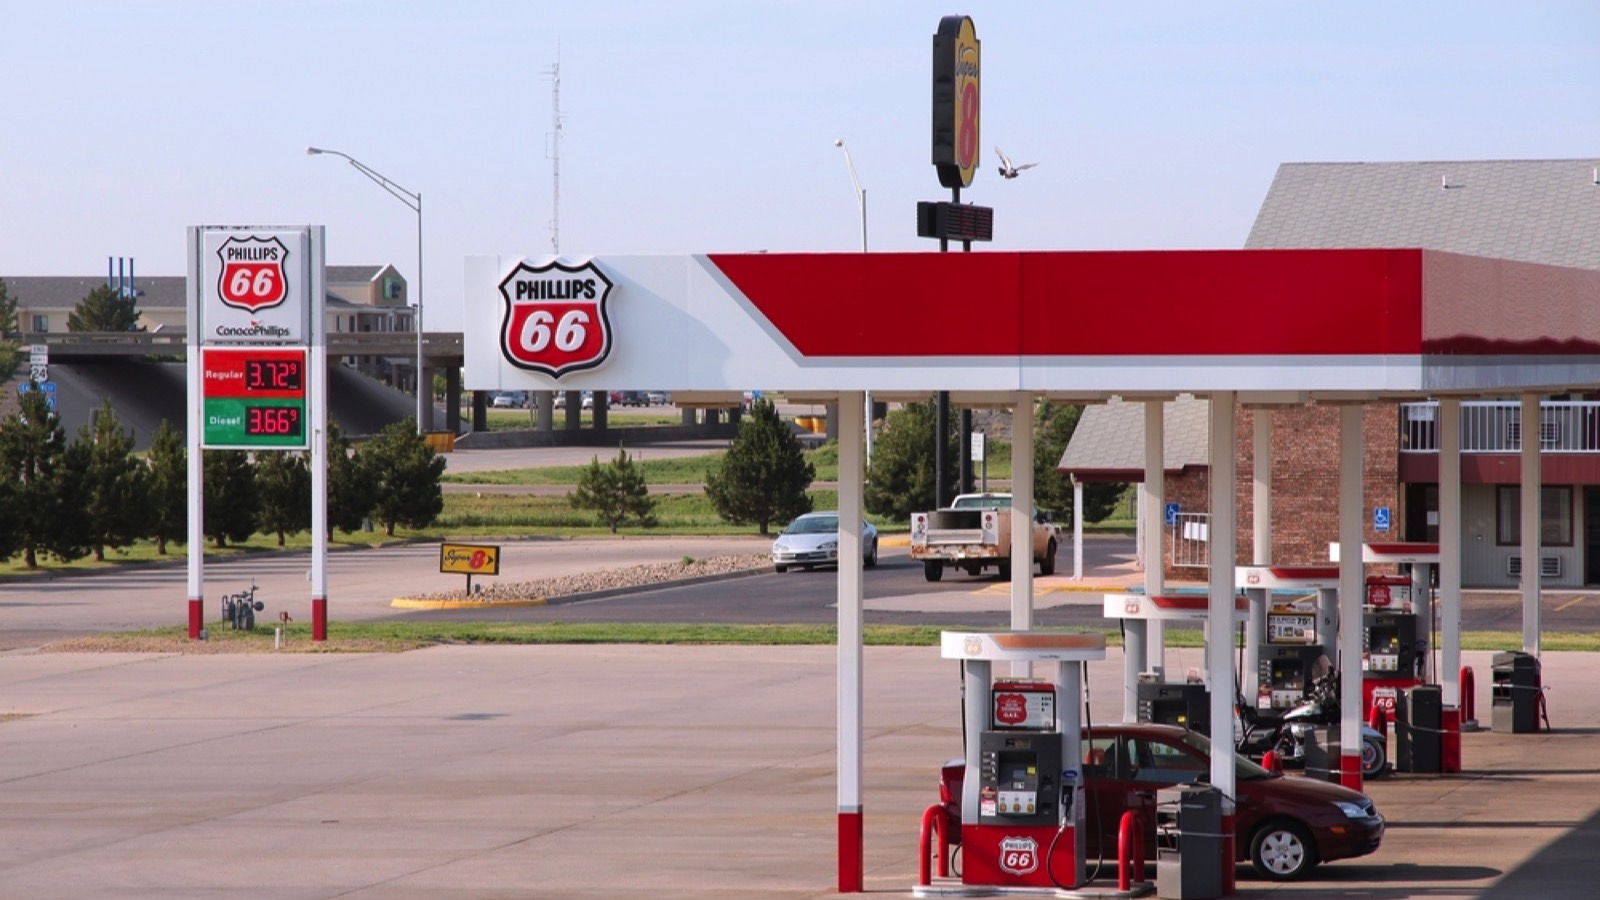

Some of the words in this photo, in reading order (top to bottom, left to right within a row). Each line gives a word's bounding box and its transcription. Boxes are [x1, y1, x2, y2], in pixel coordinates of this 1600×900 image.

[960, 82, 977, 169] 8
[228, 248, 278, 261] PHILLIPS
[230, 268, 274, 297] 66
[516, 279, 596, 300] PHILLIPS
[216, 326, 290, 337] ConocoPhillips
[521, 309, 590, 353] 66
[32, 368, 46, 379] 24
[205, 370, 243, 380] Regular
[209, 416, 240, 425] Diesel
[470, 549, 486, 569] 8
[1377, 698, 1393, 708] 66
[1004, 842, 1033, 850] PHILLIPS
[1007, 852, 1030, 867] 66
